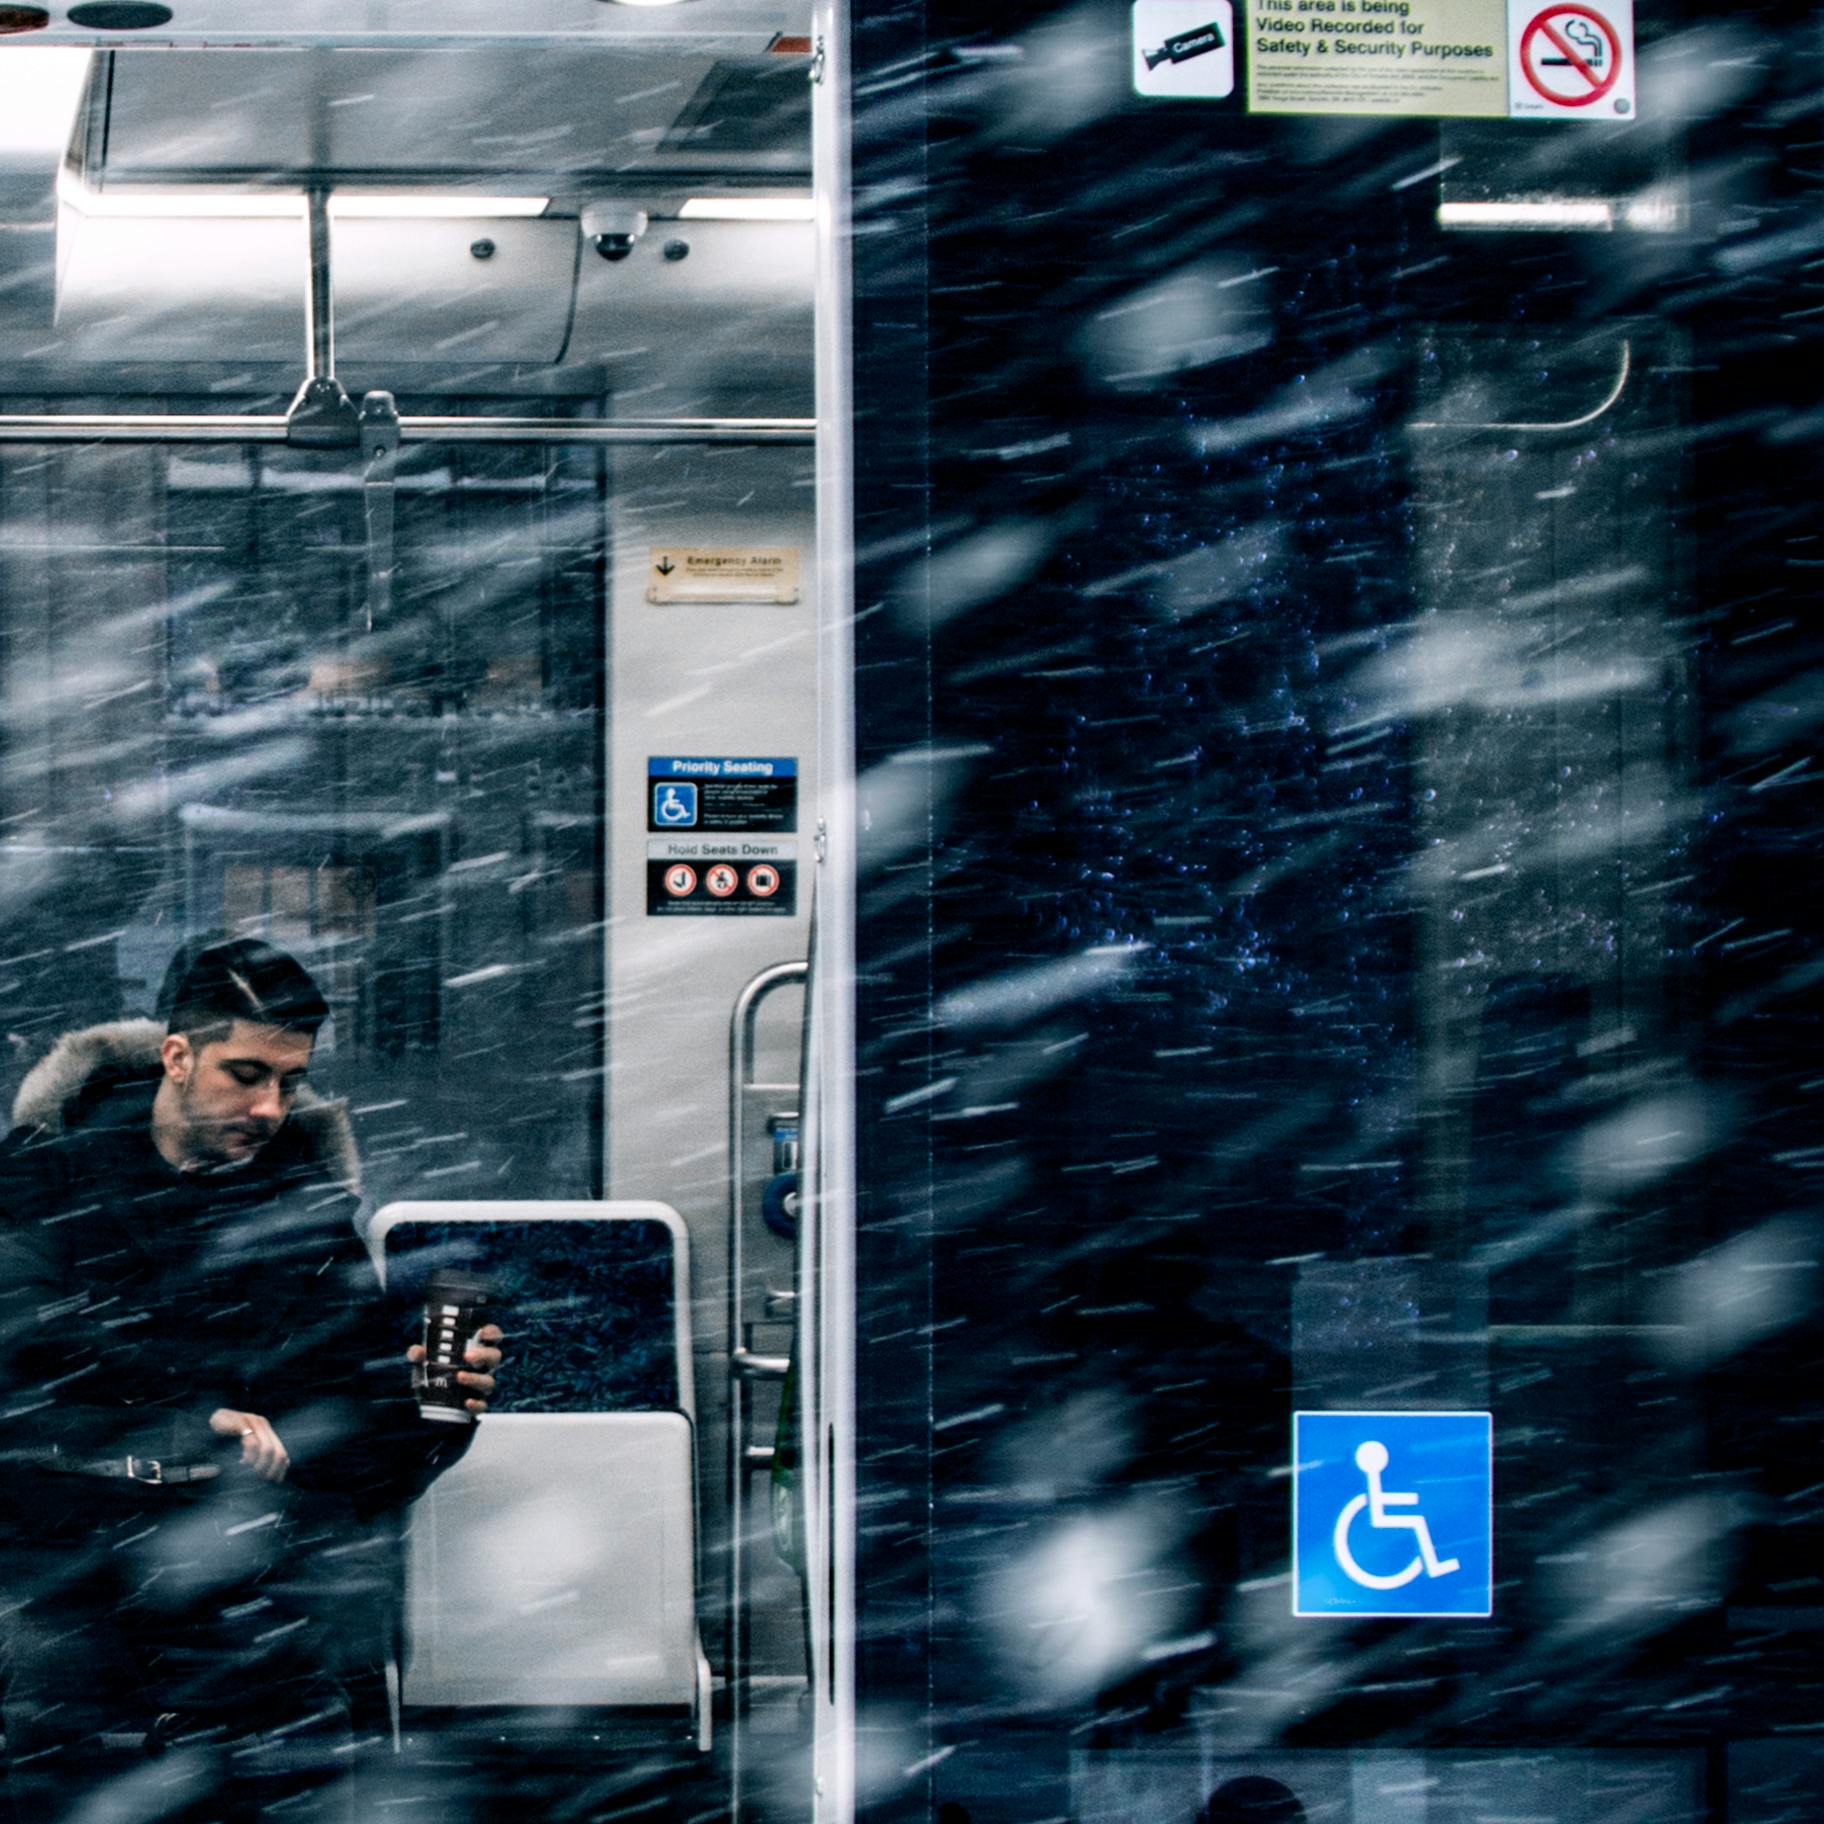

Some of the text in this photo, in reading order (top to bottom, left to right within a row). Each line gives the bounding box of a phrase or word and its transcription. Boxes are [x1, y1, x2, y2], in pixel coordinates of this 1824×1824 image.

[1256, 17, 1424, 34] Video Recorded for
[1172, 32, 1216, 53] Camera
[1256, 38, 1493, 60] Safety & Security Purposes
[687, 556, 782, 567] Emergency Alarm
[672, 760, 774, 776] Priority Seating
[668, 844, 778, 855] Hold Seats Down
